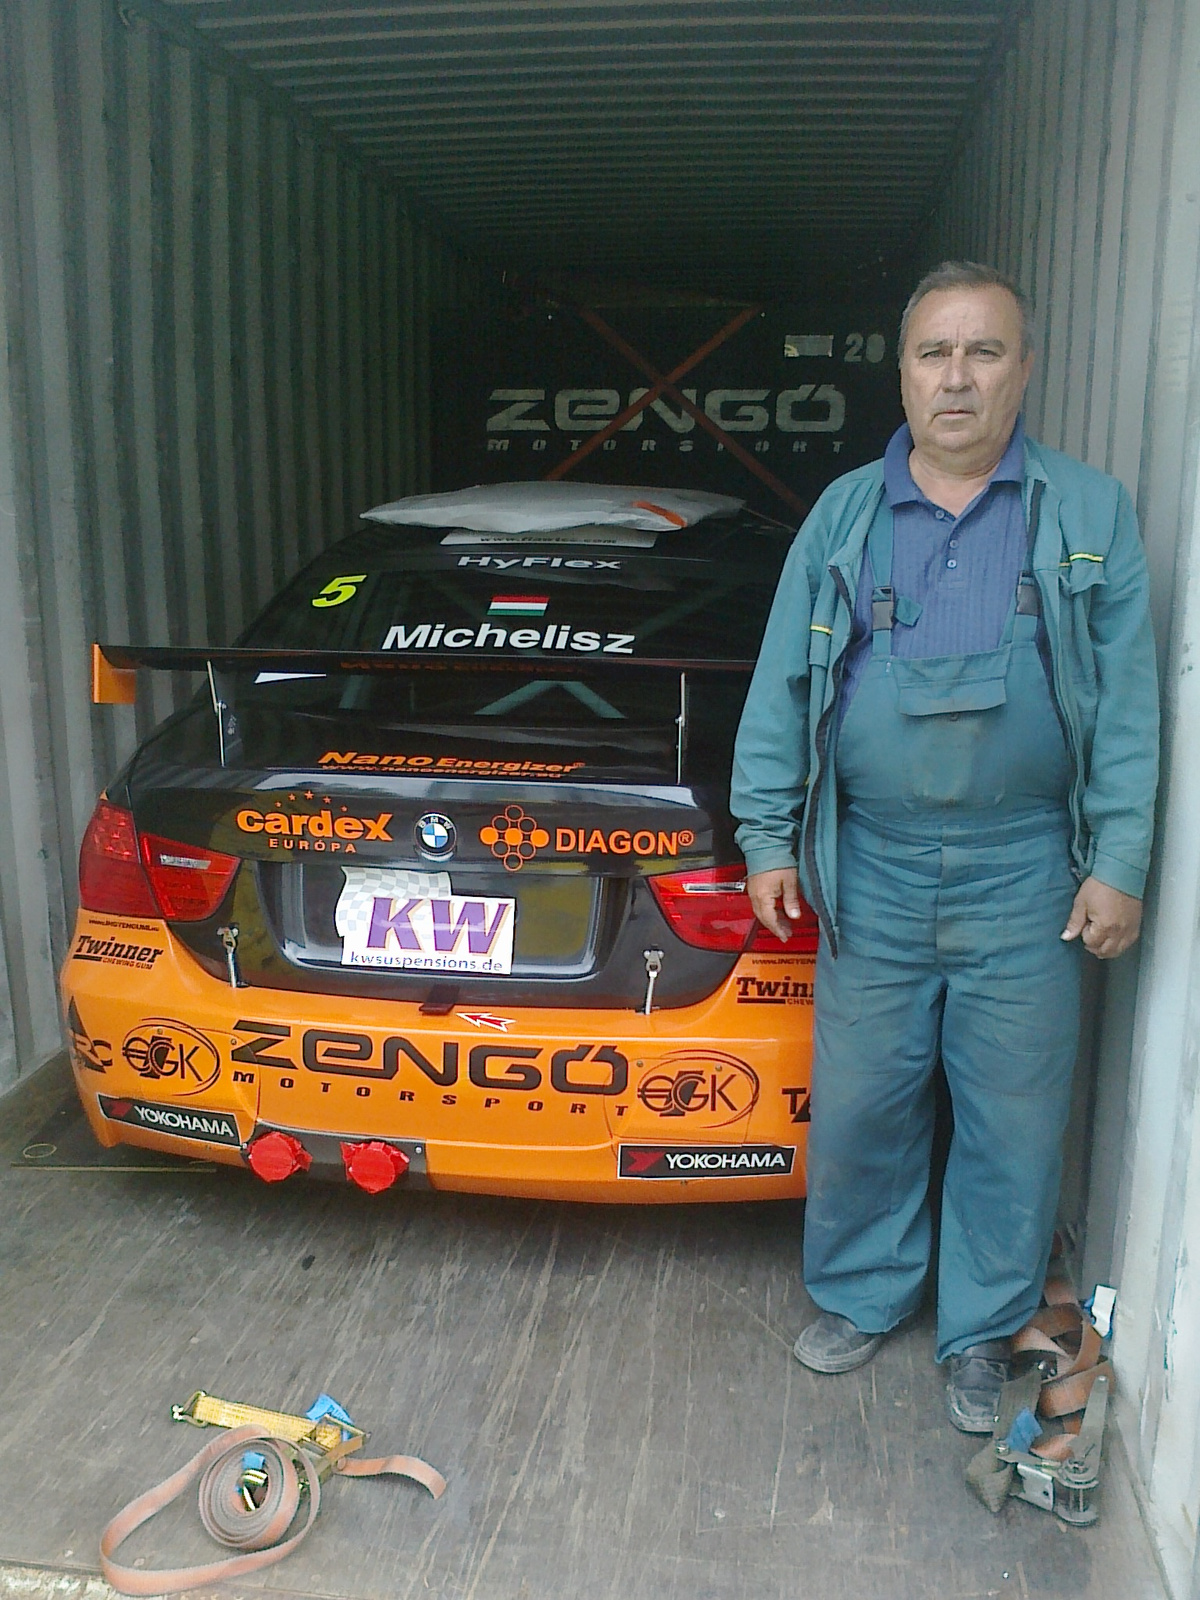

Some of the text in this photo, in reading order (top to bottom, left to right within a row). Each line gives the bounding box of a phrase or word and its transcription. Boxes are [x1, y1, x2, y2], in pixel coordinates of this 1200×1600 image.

[457, 556, 621, 570] HyFlex
[312, 575, 367, 607] 5
[381, 623, 635, 654] Michelisz
[237, 809, 393, 842] cardex
[418, 816, 454, 830] BMW
[366, 897, 513, 956] KW
[76, 935, 164, 963] Twinner
[350, 951, 503, 971] kwsuspensions.de
[736, 976, 814, 997] Twin
[786, 998, 814, 1006] CHEW
[134, 1105, 235, 1138] YOKOHAMA
[665, 1152, 786, 1170] YOKOHAMA
